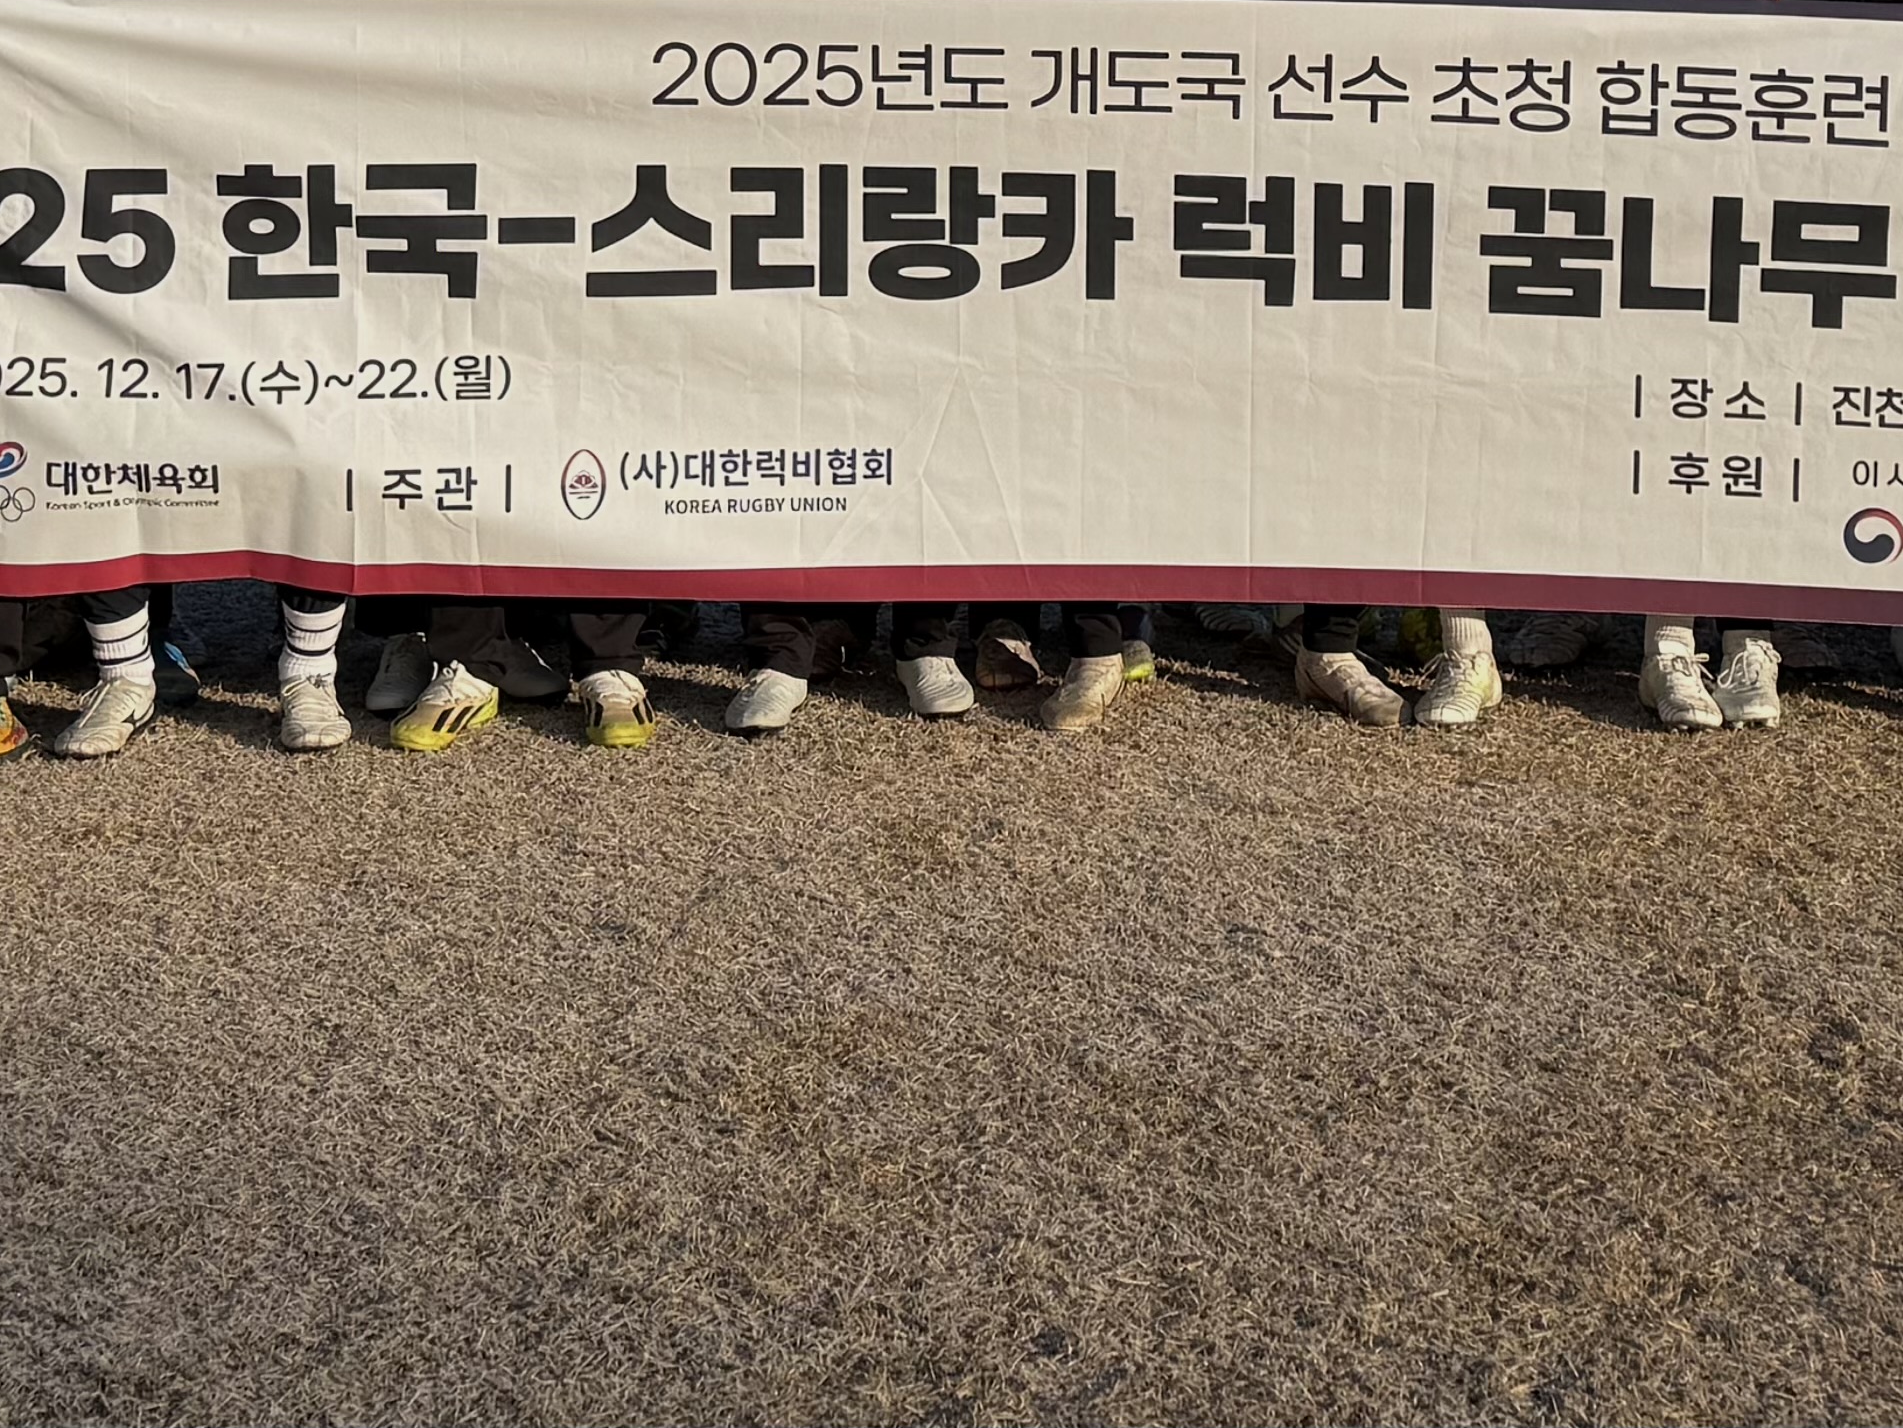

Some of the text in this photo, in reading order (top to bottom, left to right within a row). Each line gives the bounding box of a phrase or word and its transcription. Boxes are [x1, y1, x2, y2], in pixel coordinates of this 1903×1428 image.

[653, 42, 1889, 147] 2025년도 개도국 선수 초청 합동훈련
[1174, 175, 1434, 310] 럭비
[1480, 186, 1897, 329] 꿈나무
[98, 358, 159, 398] 12.
[46, 462, 219, 495] 대한체육회
[621, 448, 891, 490] (사)대한럭비협회
[1853, 461, 1878, 487] 이
[665, 497, 846, 514] KOREA RUGBY UNION
